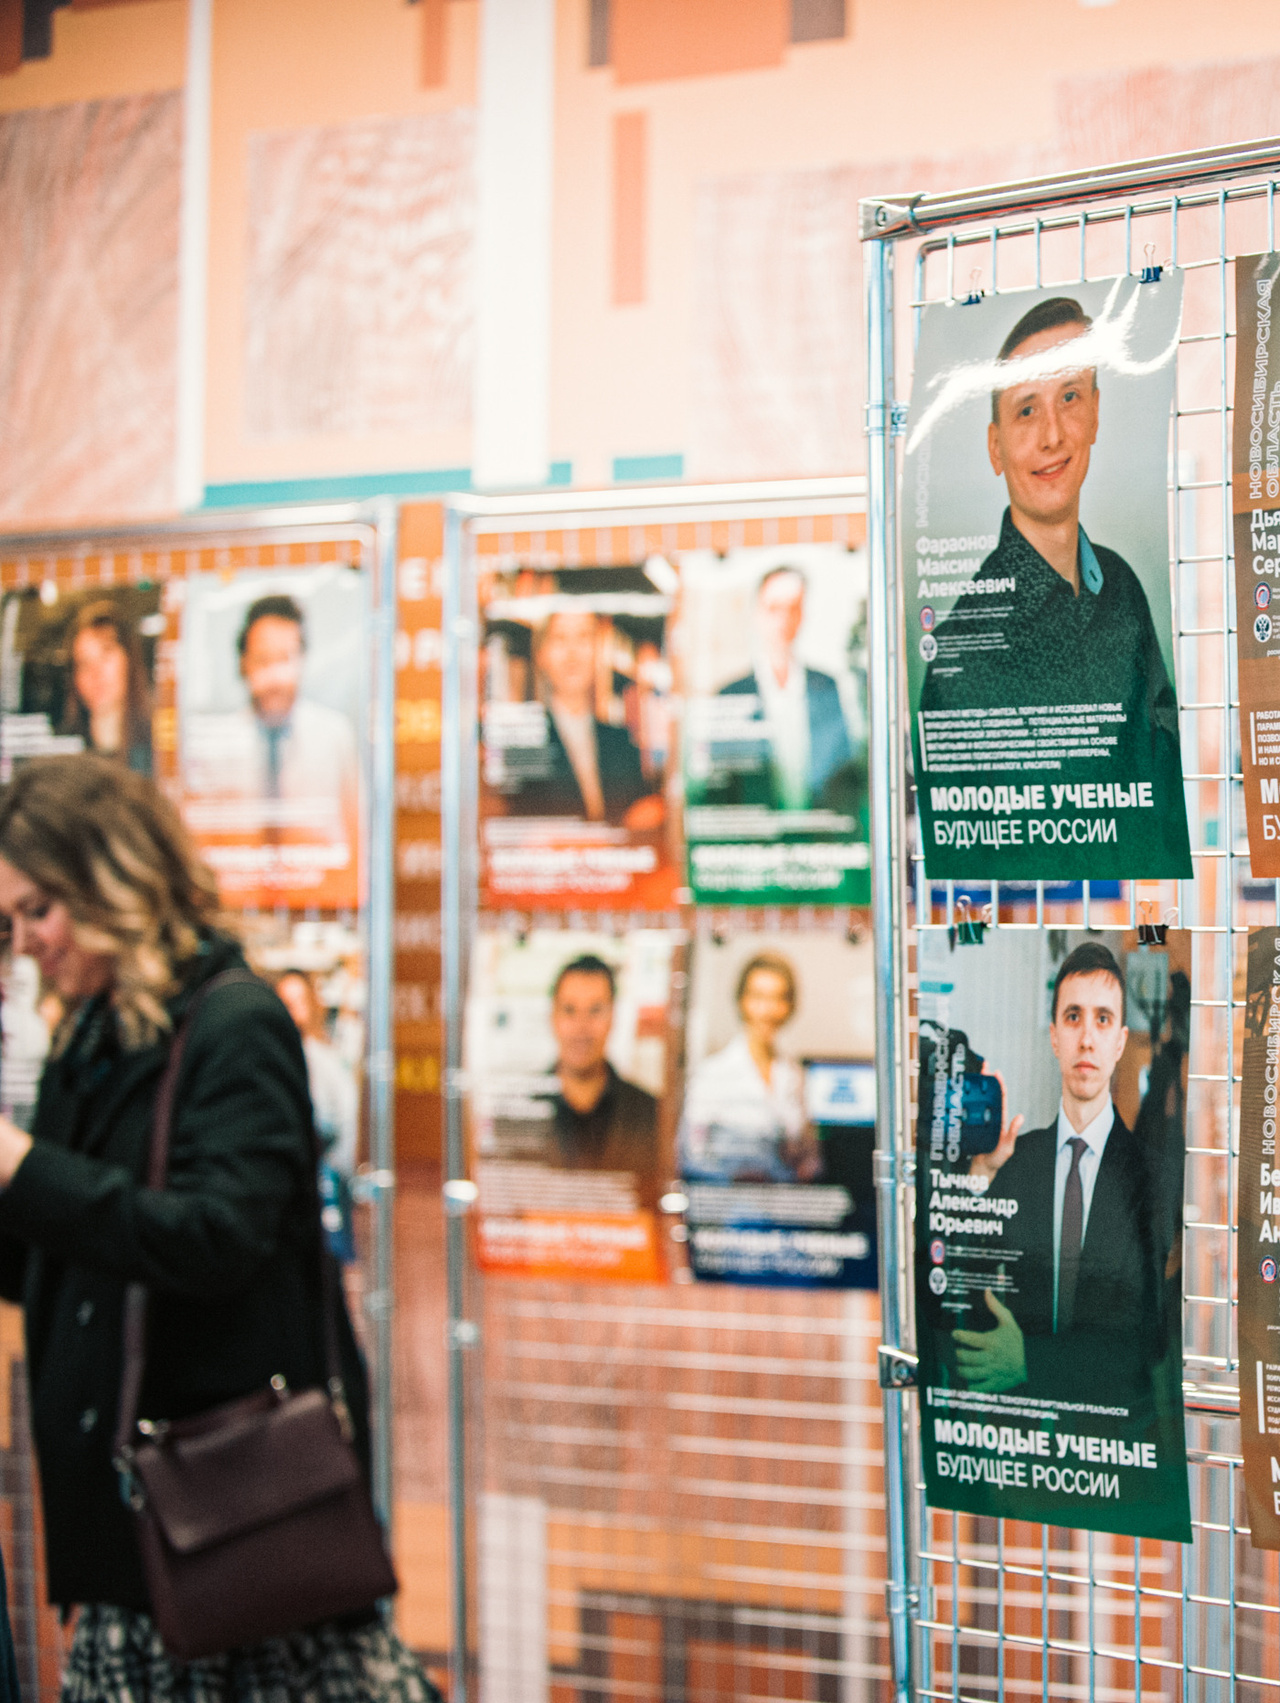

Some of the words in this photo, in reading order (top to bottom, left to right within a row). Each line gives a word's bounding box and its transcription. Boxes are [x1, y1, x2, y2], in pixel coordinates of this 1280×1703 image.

[1250, 279, 1272, 500] НОВОСИБИРСКАЯ
[915, 534, 998, 558] Фараонов
[916, 558, 981, 577] Максим
[917, 577, 1016, 599] Алексеевич
[1256, 710, 1280, 719] РАБОТА
[1258, 746, 1263, 754] И
[1258, 757, 1268, 766] НО
[1269, 757, 1274, 765] И
[930, 784, 1046, 815] МОЛОДЫЕ
[1050, 782, 1154, 810] УЧЕНЫЕ
[933, 820, 1023, 850] БУДУЩЕЕ
[1028, 818, 1118, 844] РОССИИ
[929, 1168, 989, 1192] Тычков
[929, 1191, 1018, 1218] Александр
[929, 1214, 1003, 1236] Юрьевич
[934, 1418, 1050, 1456] МОЛОДЫЕ
[1056, 1432, 1157, 1469] УЧЕНЫЕ
[936, 1452, 1028, 1490] БУДУЩЕЕ
[1032, 1464, 1120, 1499] РОССИИ
